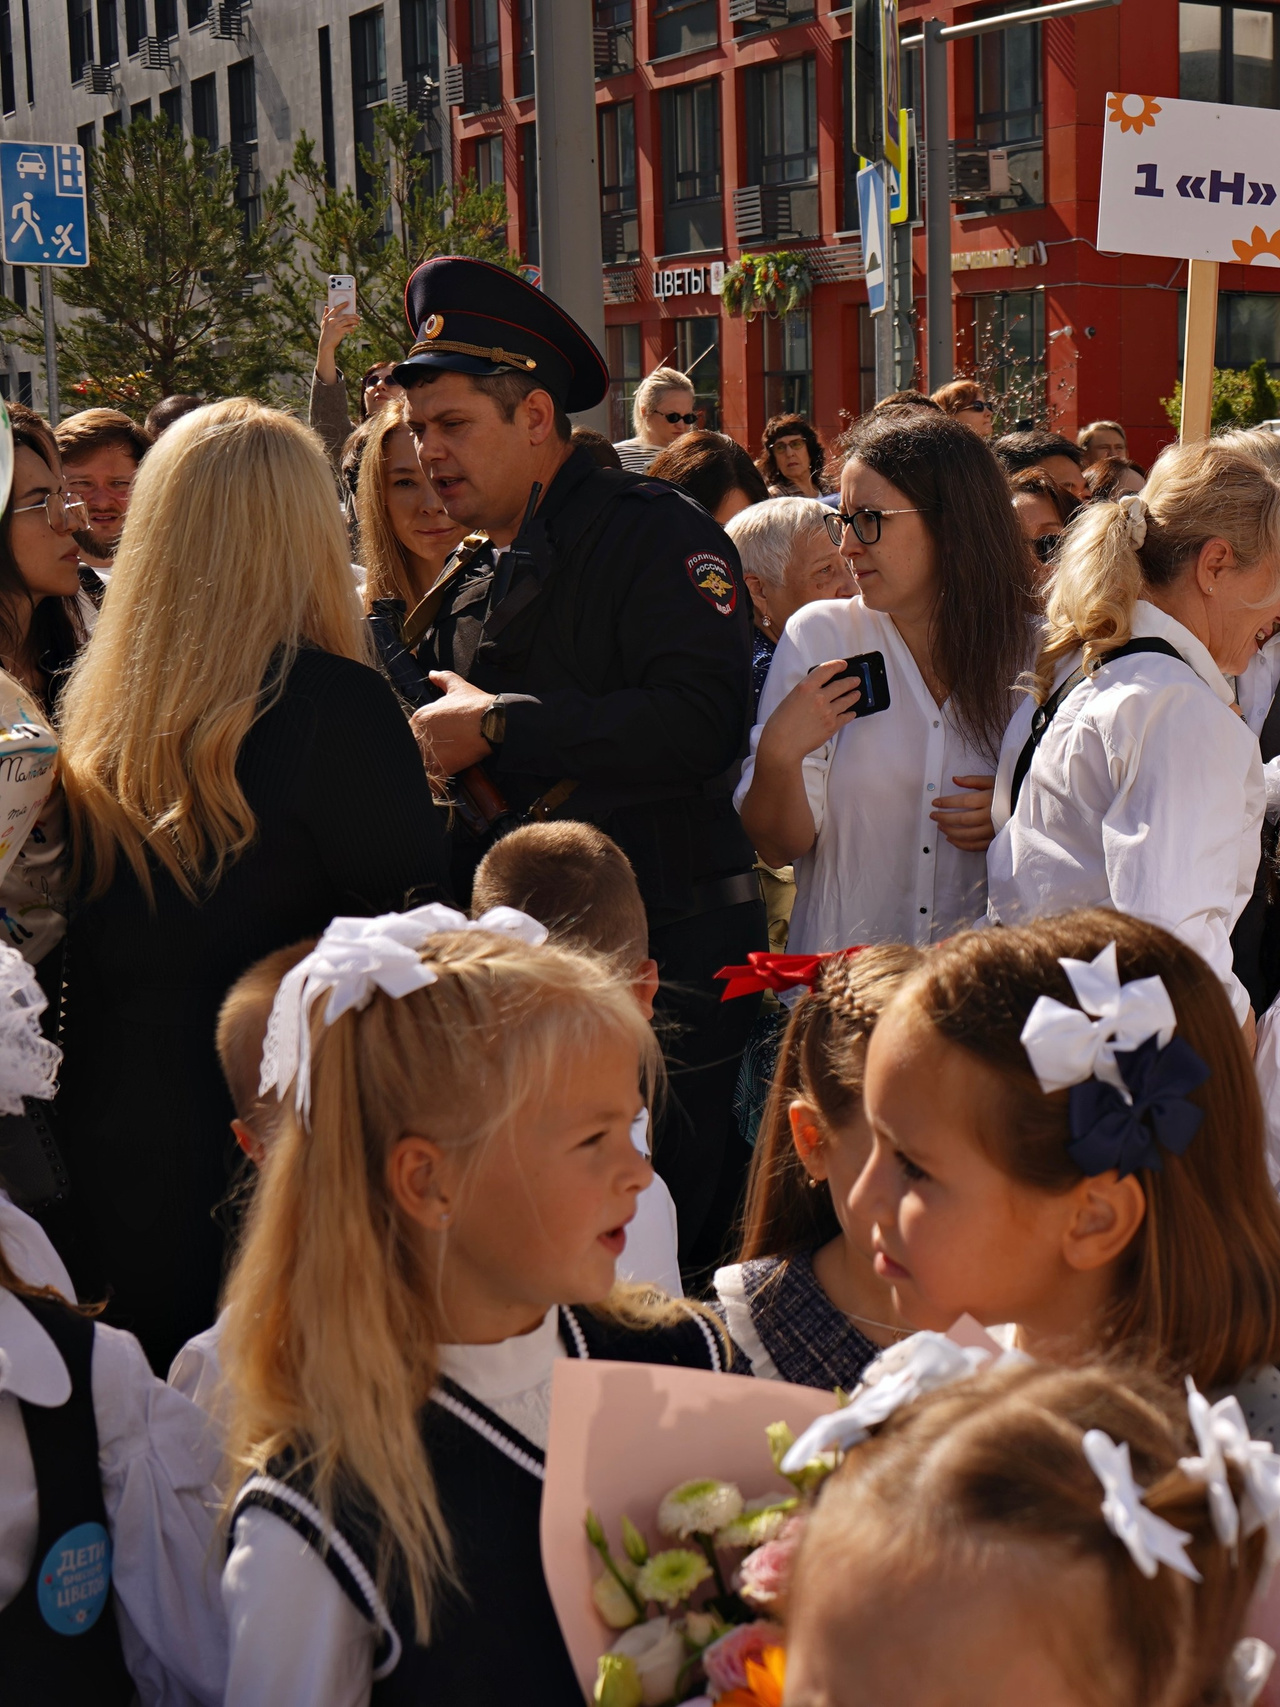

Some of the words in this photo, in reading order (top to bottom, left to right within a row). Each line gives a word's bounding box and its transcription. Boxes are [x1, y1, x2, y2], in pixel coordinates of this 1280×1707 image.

[1134, 163, 1164, 197] 1
[653, 267, 705, 302] ЦВЕТЫ
[687, 553, 727, 569] ПОЛИЦИЯ
[696, 563, 727, 577] РОССИЯ
[715, 601, 732, 615] МВД
[56, 1540, 106, 1577] ДЕТИ
[57, 1575, 105, 1608] ЦВЕТОВ
